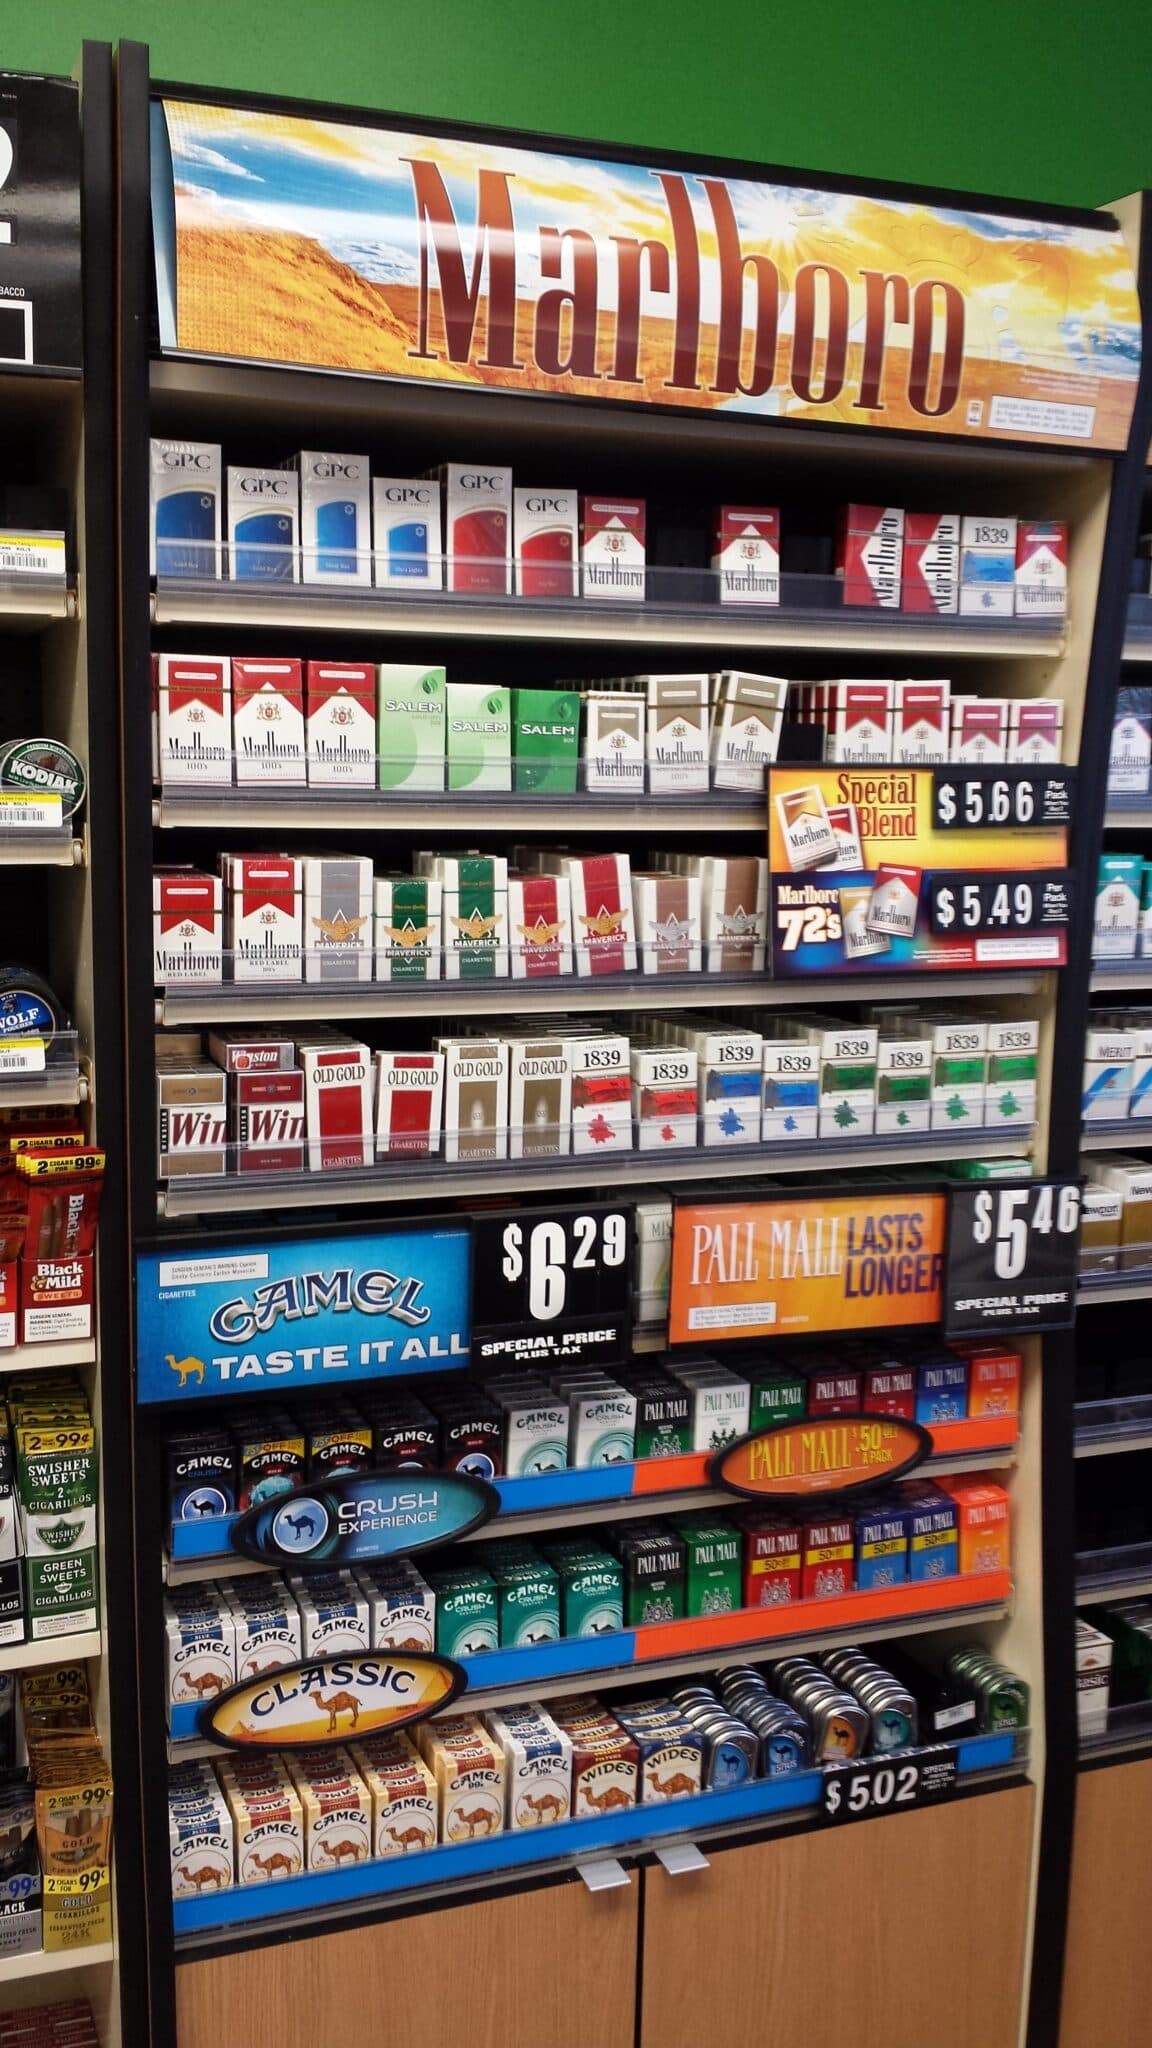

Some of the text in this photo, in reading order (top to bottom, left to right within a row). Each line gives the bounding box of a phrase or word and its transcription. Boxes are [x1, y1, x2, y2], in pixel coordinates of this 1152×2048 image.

[398, 157, 965, 418] Marlboro
[162, 452, 211, 470] GPC
[314, 462, 359, 480] GPC
[240, 478, 288, 496] GPC
[460, 474, 503, 491] GPC
[385, 487, 431, 505] GPC
[525, 498, 568, 514] GPC
[974, 525, 1009, 544] 1839
[867, 516, 900, 607] Marlboro
[924, 524, 954, 609] Marlboro
[586, 558, 643, 587] Marlboro
[724, 563, 778, 593] Marlboro
[385, 700, 442, 713] SALEM
[452, 721, 508, 734] SALEM
[521, 722, 575, 735] SALEM
[169, 732, 226, 761] Marlboro
[243, 731, 300, 760] Marlboro
[316, 735, 371, 763] Marlboro
[656, 742, 704, 765] Marlboro
[596, 752, 643, 778] Marlboro
[11, 759, 78, 795] KODIAK
[837, 772, 918, 805] Special
[858, 806, 918, 837] Blend
[789, 828, 831, 847] Marlboro
[778, 885, 839, 904] Marlboro
[777, 906, 842, 950] 72's
[238, 930, 300, 959] Marlboro
[455, 940, 500, 948] MAVERICK
[520, 944, 564, 954] MAVERICK
[584, 935, 627, 945] MAVERICK
[157, 942, 220, 971] Marlboro
[386, 949, 432, 958] MAVERICK
[834, 1040, 868, 1058] 1839
[946, 1035, 980, 1052] 1839
[998, 1033, 1031, 1050] 1839
[584, 1050, 621, 1069] 1839
[720, 1045, 754, 1063] 1839
[890, 1054, 923, 1070] 1839
[313, 1065, 366, 1084] OLD GOLD
[454, 1061, 502, 1077] OLD GOLD
[519, 1059, 567, 1077] OLD GOLD
[653, 1063, 689, 1081] 1839
[776, 1056, 811, 1074] 1839
[388, 1070, 439, 1086] OLD GOLD
[38, 1161, 49, 1174] 2
[67, 1193, 85, 1239] Black
[846, 1213, 924, 1256] LASTS
[691, 1215, 842, 1284] PALL MALL
[38, 1262, 84, 1278] Black
[843, 1252, 943, 1299] LONGER
[46, 1275, 83, 1290] Mild
[210, 1268, 433, 1343] CAMEL
[954, 1292, 1069, 1313] SPECIAL PRICE
[480, 1329, 618, 1358] SPECIAL PRICE
[515, 1345, 582, 1361] PLUS TAX
[213, 1332, 470, 1381] TASTE IT ALL
[816, 1379, 856, 1399] PALL MALL
[872, 1373, 912, 1394] PALL MALL
[704, 1390, 745, 1411] PALL MALL
[760, 1386, 801, 1408] PALL MALL
[516, 1412, 565, 1429] CAMEL
[585, 1403, 632, 1419] CAMEL
[645, 1399, 688, 1422] PALL MALL
[382, 1431, 435, 1448] CAMEL
[449, 1422, 500, 1440] CAMEL
[29, 1436, 41, 1450] 2
[320, 1445, 366, 1460] CAMEL
[251, 1451, 299, 1469] CAMEL
[748, 1427, 852, 1481] PALL MALL
[28, 1459, 91, 1477] SWISHER
[176, 1455, 233, 1475] CAMEL
[31, 1470, 86, 1487] SWEETS
[29, 1493, 91, 1511] CIGARILLOS
[57, 1487, 64, 1498] 2
[337, 1491, 438, 1519] CRUSH
[338, 1510, 437, 1535] EXPERIENCE
[864, 1521, 903, 1542] PALL MALL
[914, 1511, 953, 1534] PALL MALL
[757, 1534, 798, 1555] PALL MALL
[810, 1524, 850, 1546] PALL MALL
[695, 1541, 738, 1564] PALL MALL
[43, 1558, 82, 1573] GREEN
[637, 1552, 680, 1575] PALL MALL
[40, 1568, 86, 1584] SWEETS
[571, 1574, 619, 1592] CAMEL
[35, 1590, 92, 1606] CIGARILLOS
[444, 1592, 494, 1612] CAMEL
[507, 1584, 556, 1602] CAMEL
[380, 1606, 432, 1627] CAMEL
[241, 1627, 296, 1650] CAMEL
[312, 1619, 366, 1640] CAMEL
[174, 1642, 230, 1662] CAMEL
[250, 1662, 415, 1717] CLASSIC
[519, 1758, 569, 1777] CAMEL
[647, 1749, 700, 1769] WIDES
[450, 1771, 502, 1791] CAMEL
[582, 1763, 635, 1784] WIDES
[381, 1796, 434, 1818] CAMEL
[313, 1811, 368, 1831] CAMEL
[243, 1824, 300, 1845] CAMEL
[172, 1838, 230, 1858] CAMEL
[47, 1879, 56, 1892] 2
